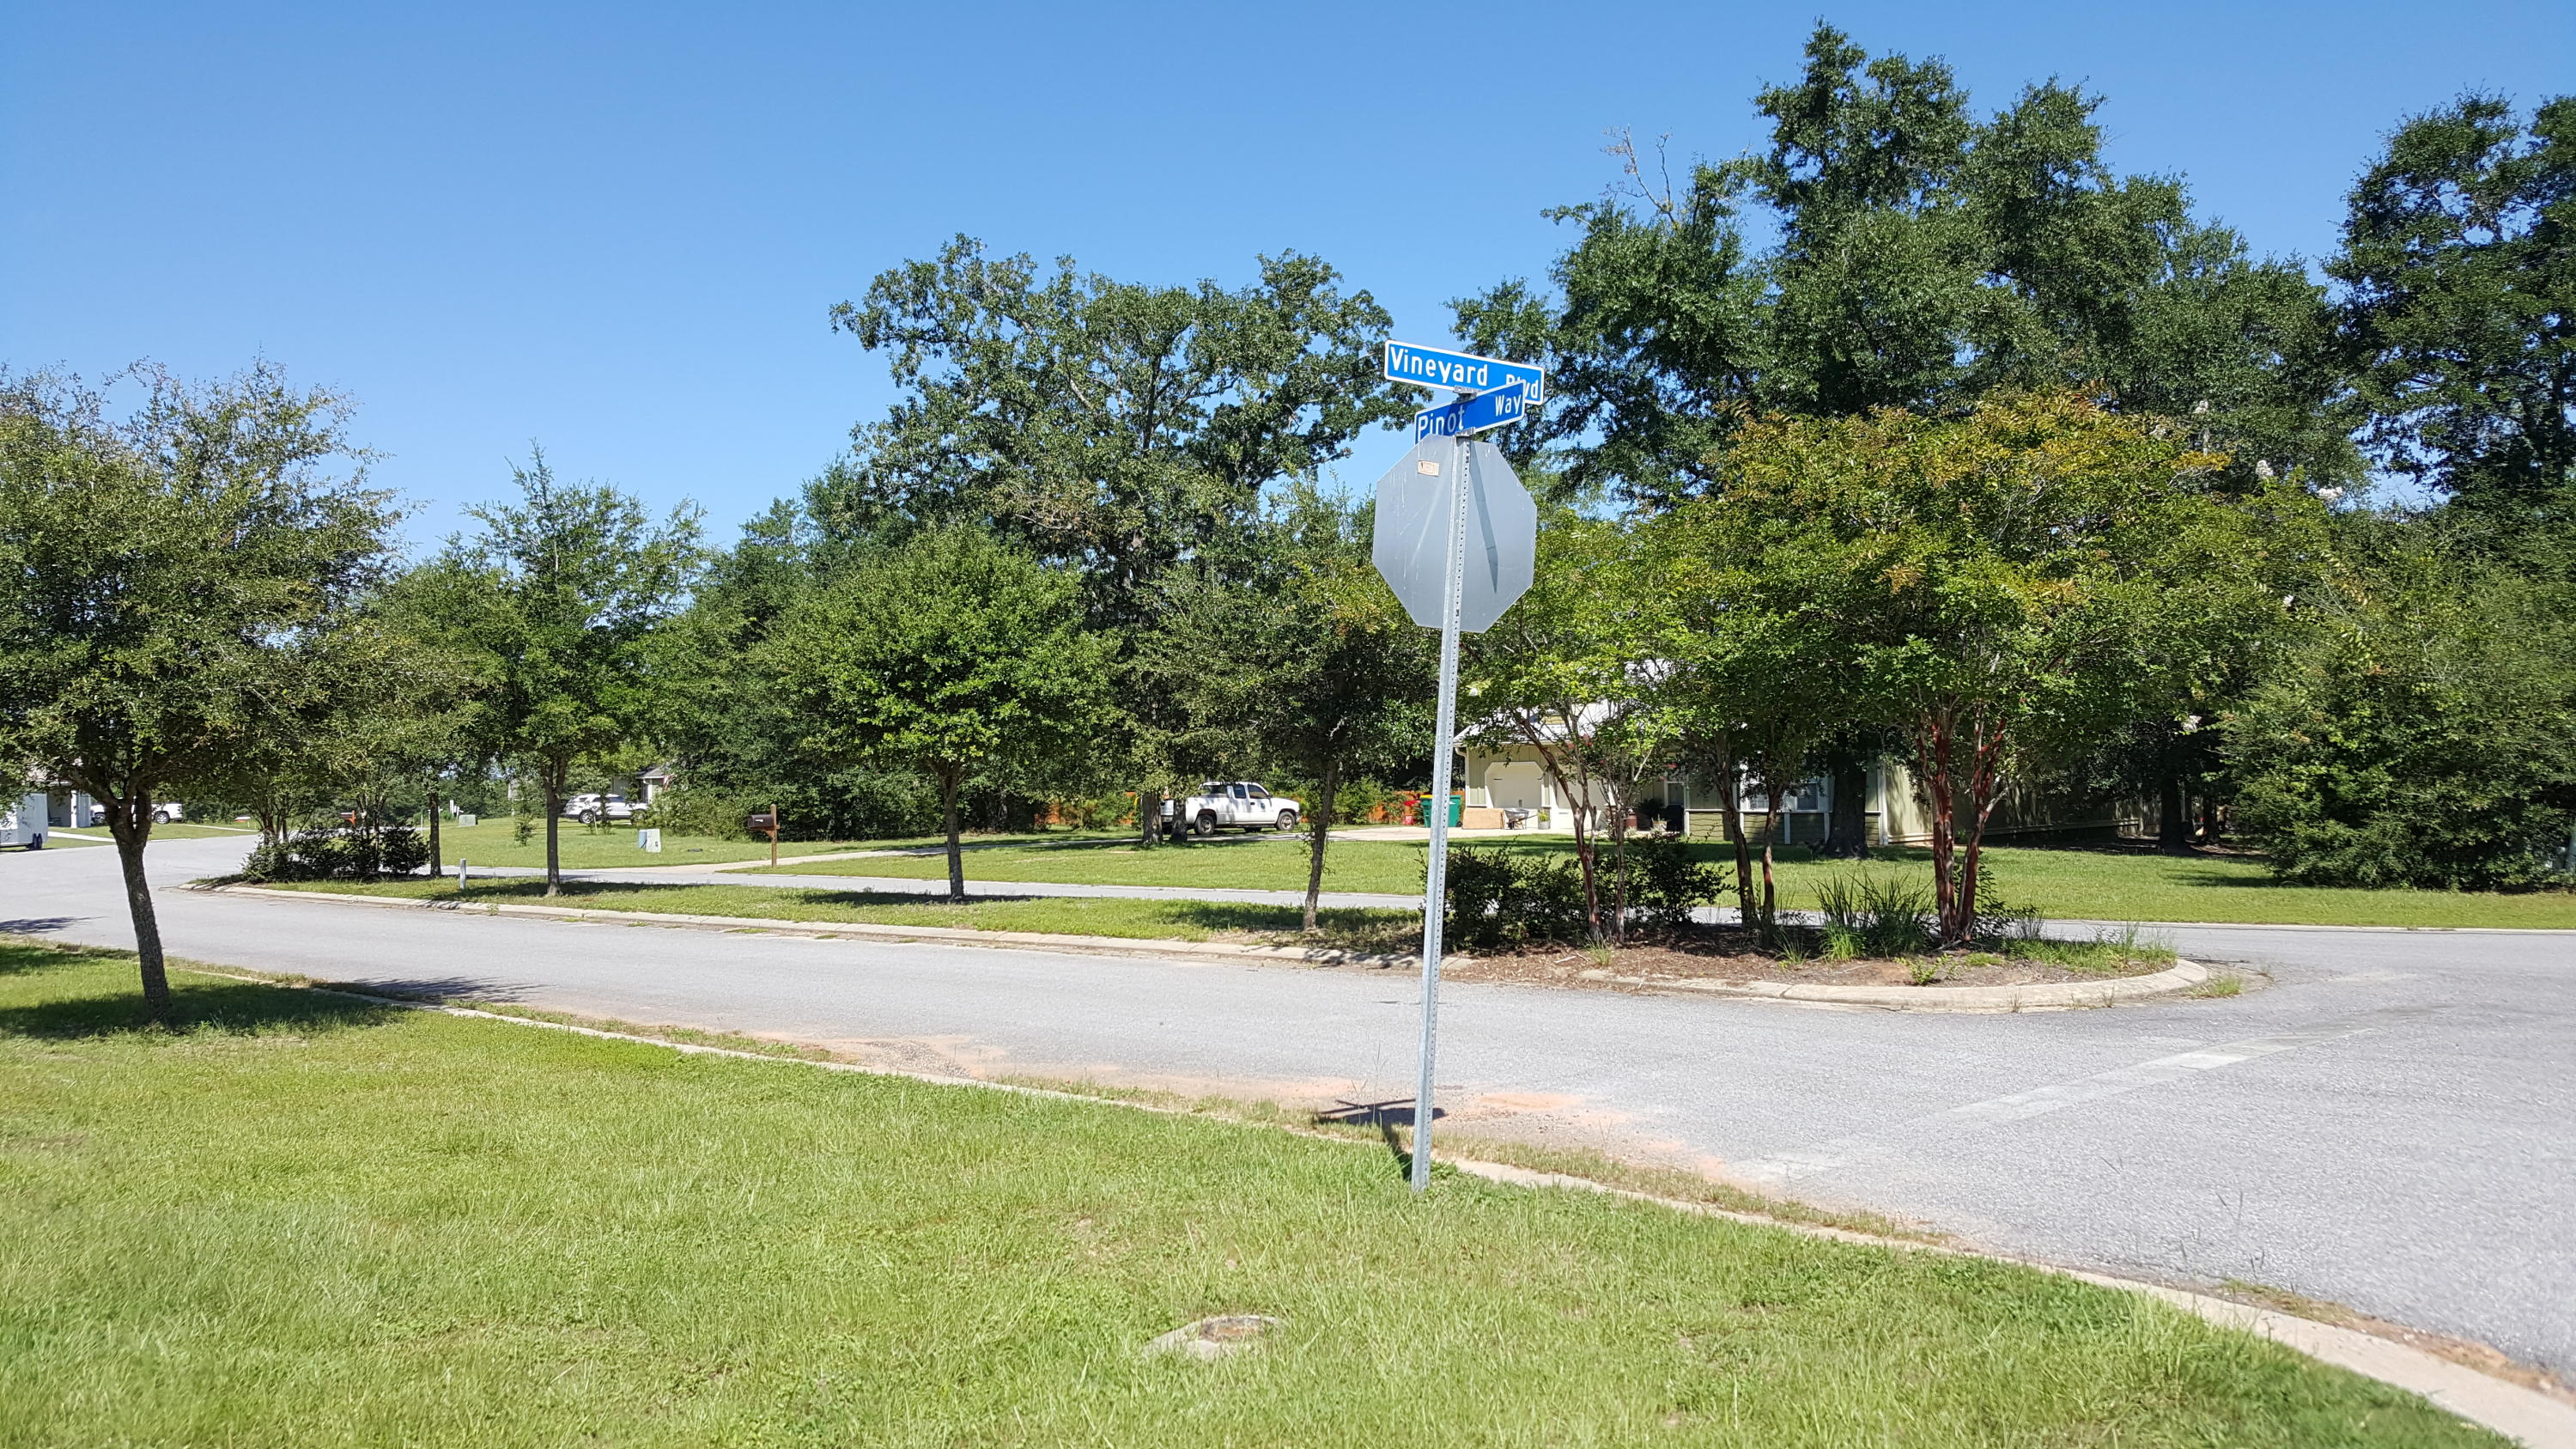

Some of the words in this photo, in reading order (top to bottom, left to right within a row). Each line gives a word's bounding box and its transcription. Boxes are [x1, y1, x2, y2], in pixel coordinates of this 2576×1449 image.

[1390, 346, 1488, 387] Vineyard
[1505, 374, 1539, 399] Bvd
[1418, 405, 1465, 442] Pinot
[1495, 394, 1522, 417] Way
